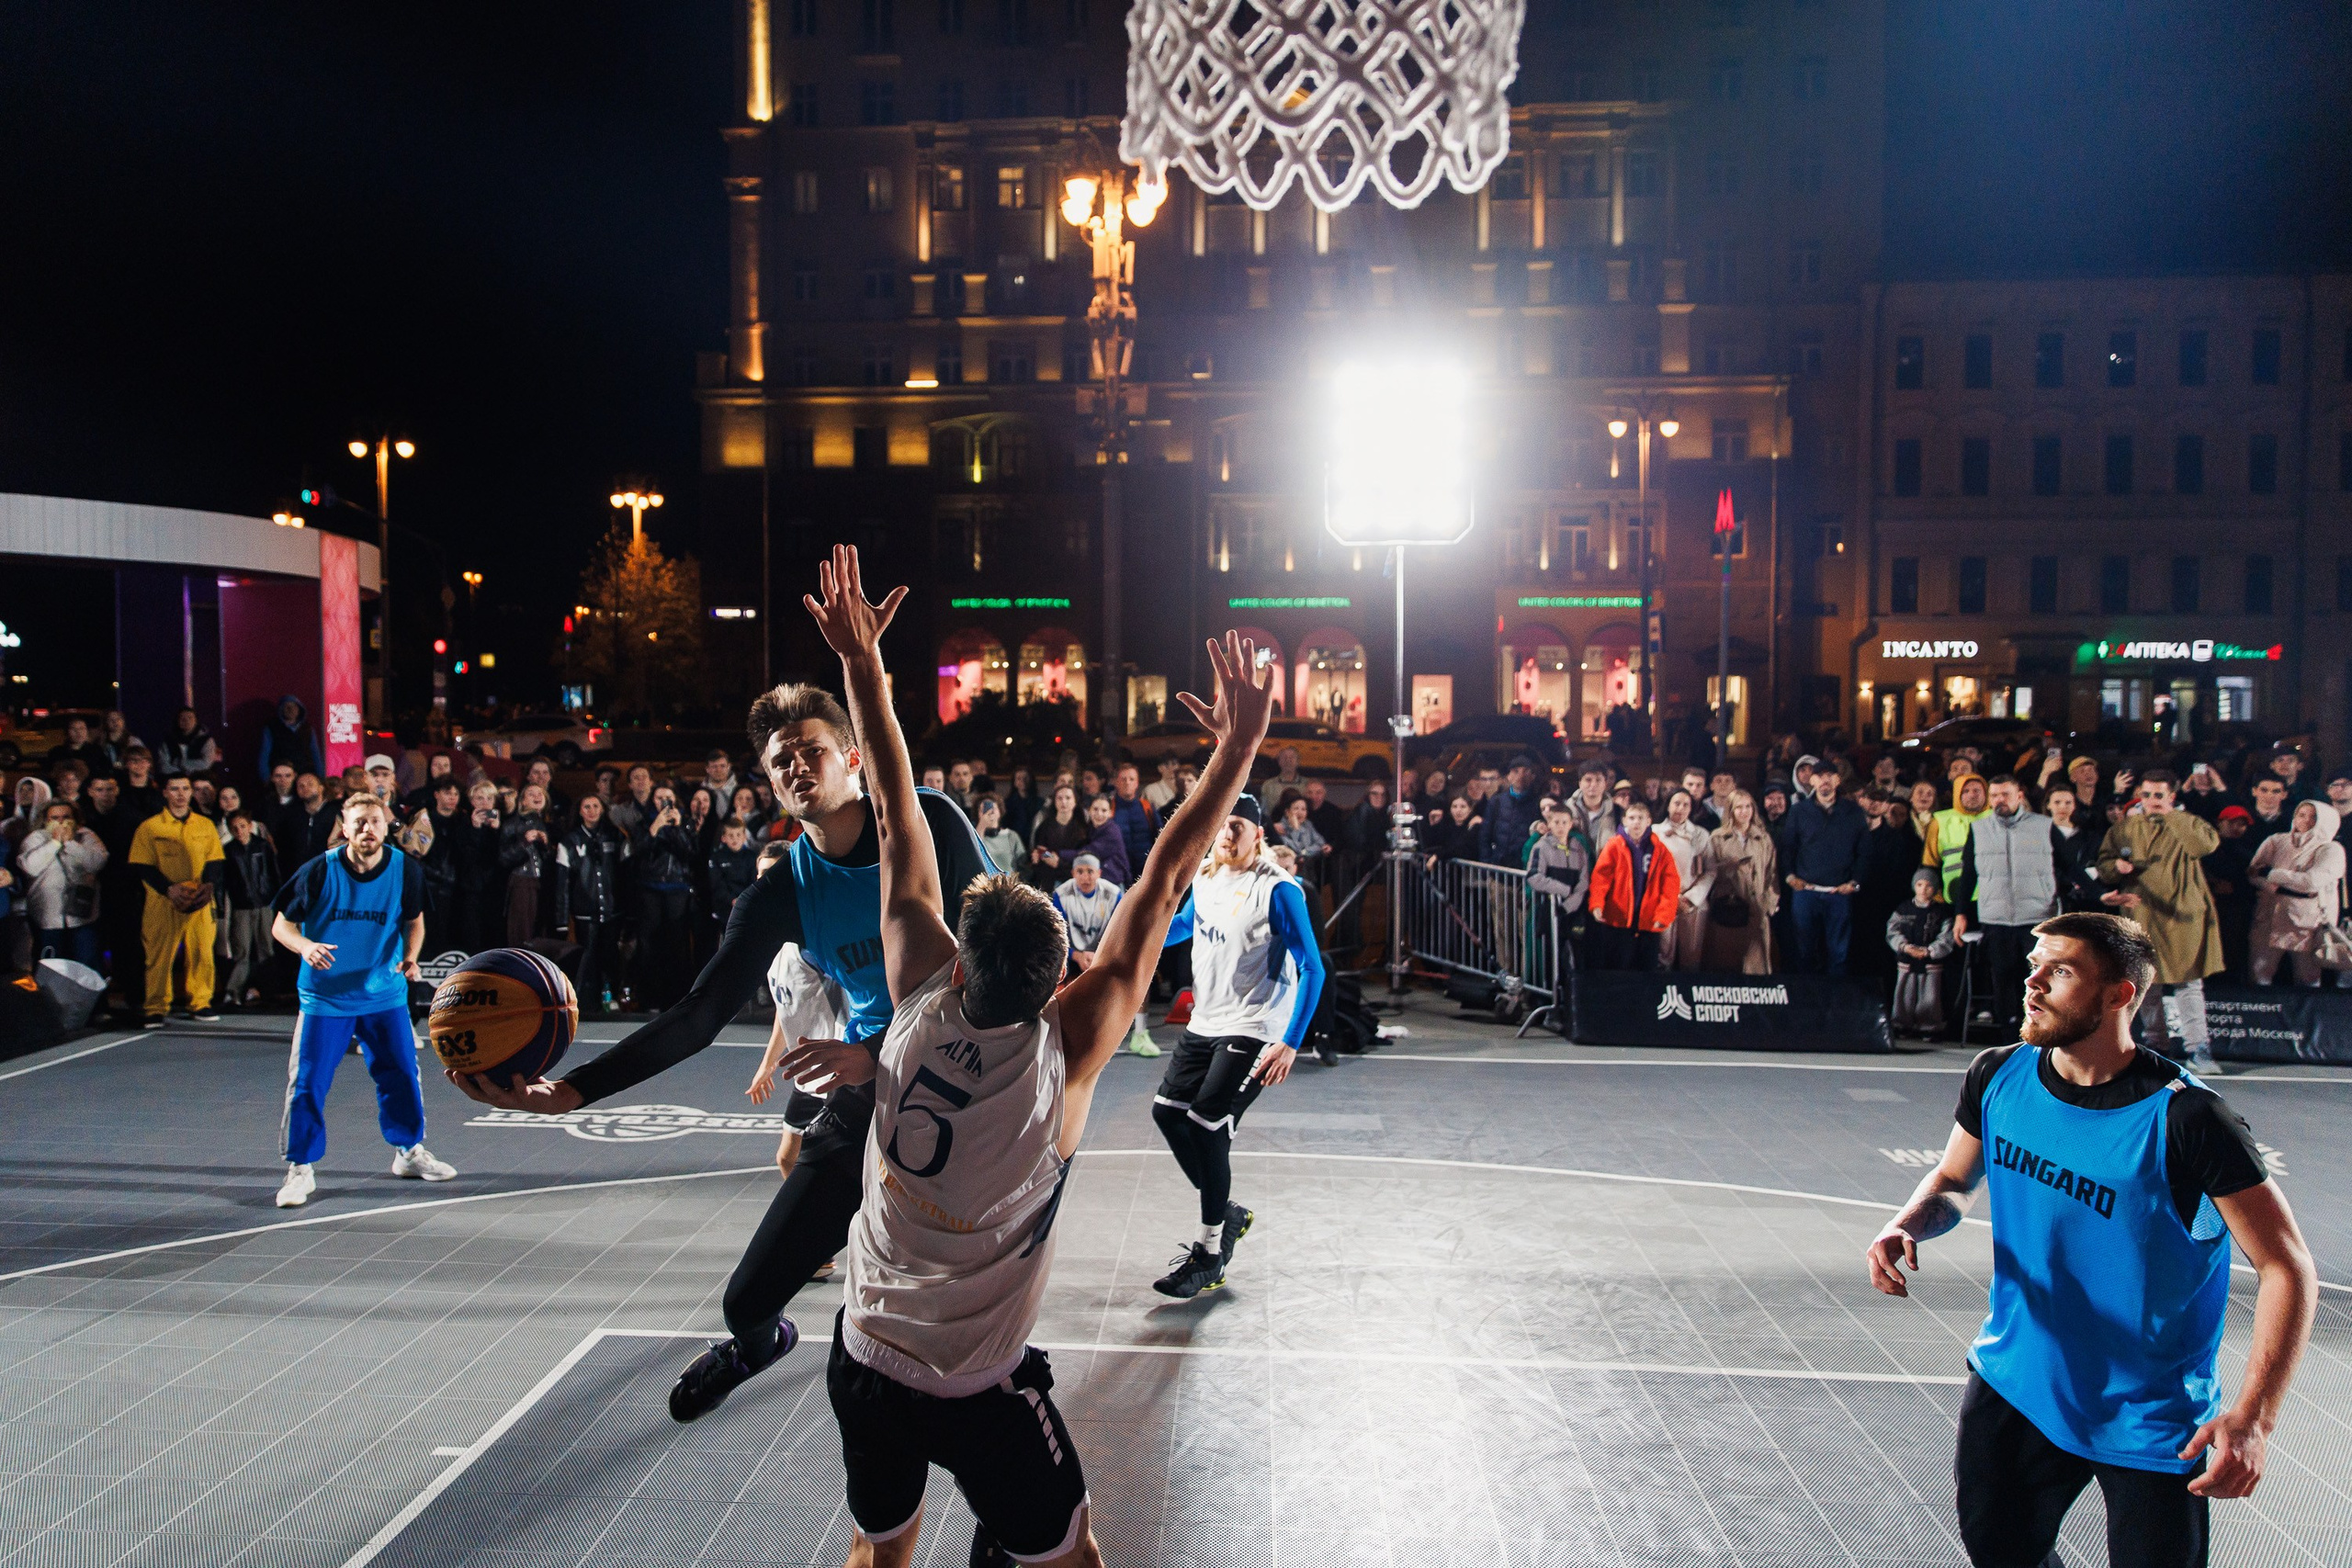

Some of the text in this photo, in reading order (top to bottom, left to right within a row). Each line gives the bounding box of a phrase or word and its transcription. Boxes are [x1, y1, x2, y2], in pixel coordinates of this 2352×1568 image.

[1883, 640, 1979, 658] INCANTO
[2123, 641, 2191, 660] АПТЕКА
[331, 908, 388, 927] SUNGARD
[836, 937, 884, 975] SUN
[1691, 984, 1789, 1005] МОСКОВСКИЙ
[1694, 1004, 1740, 1023] СПОРТ
[2205, 1000, 2282, 1013] епартамент
[2205, 1013, 2244, 1026] порта
[2207, 1027, 2304, 1041] орода Москвы
[472, 1111, 784, 1129] TREETBASKET
[886, 1064, 973, 1179] 5
[1993, 1134, 2117, 1220] SUNGARD
